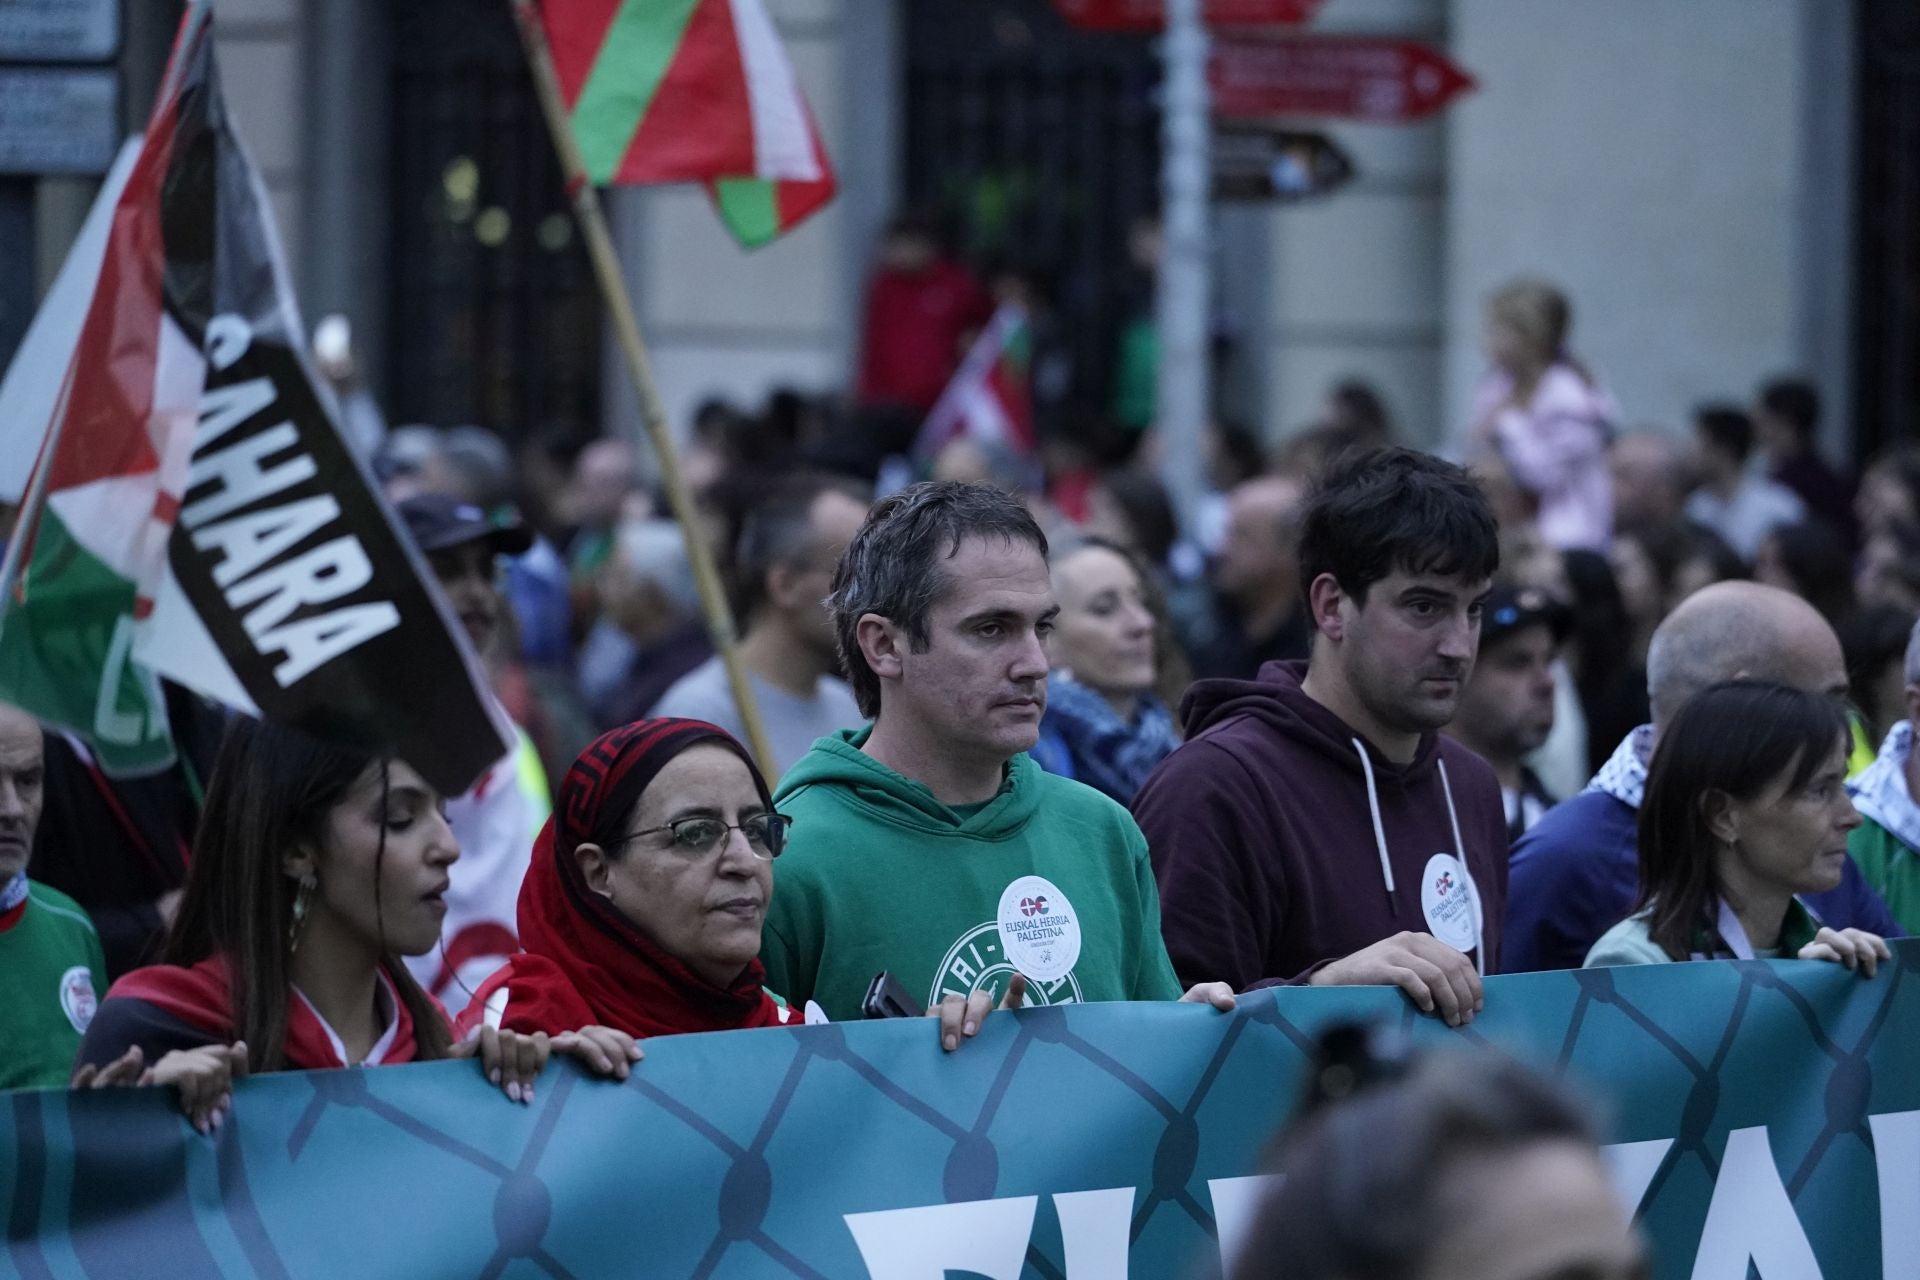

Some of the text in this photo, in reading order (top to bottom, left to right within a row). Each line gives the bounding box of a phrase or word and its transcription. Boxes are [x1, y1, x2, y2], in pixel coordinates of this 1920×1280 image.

[1005, 914, 1071, 933] EUSKAL HERRIA
[1017, 926, 1065, 942] PALESTINA
